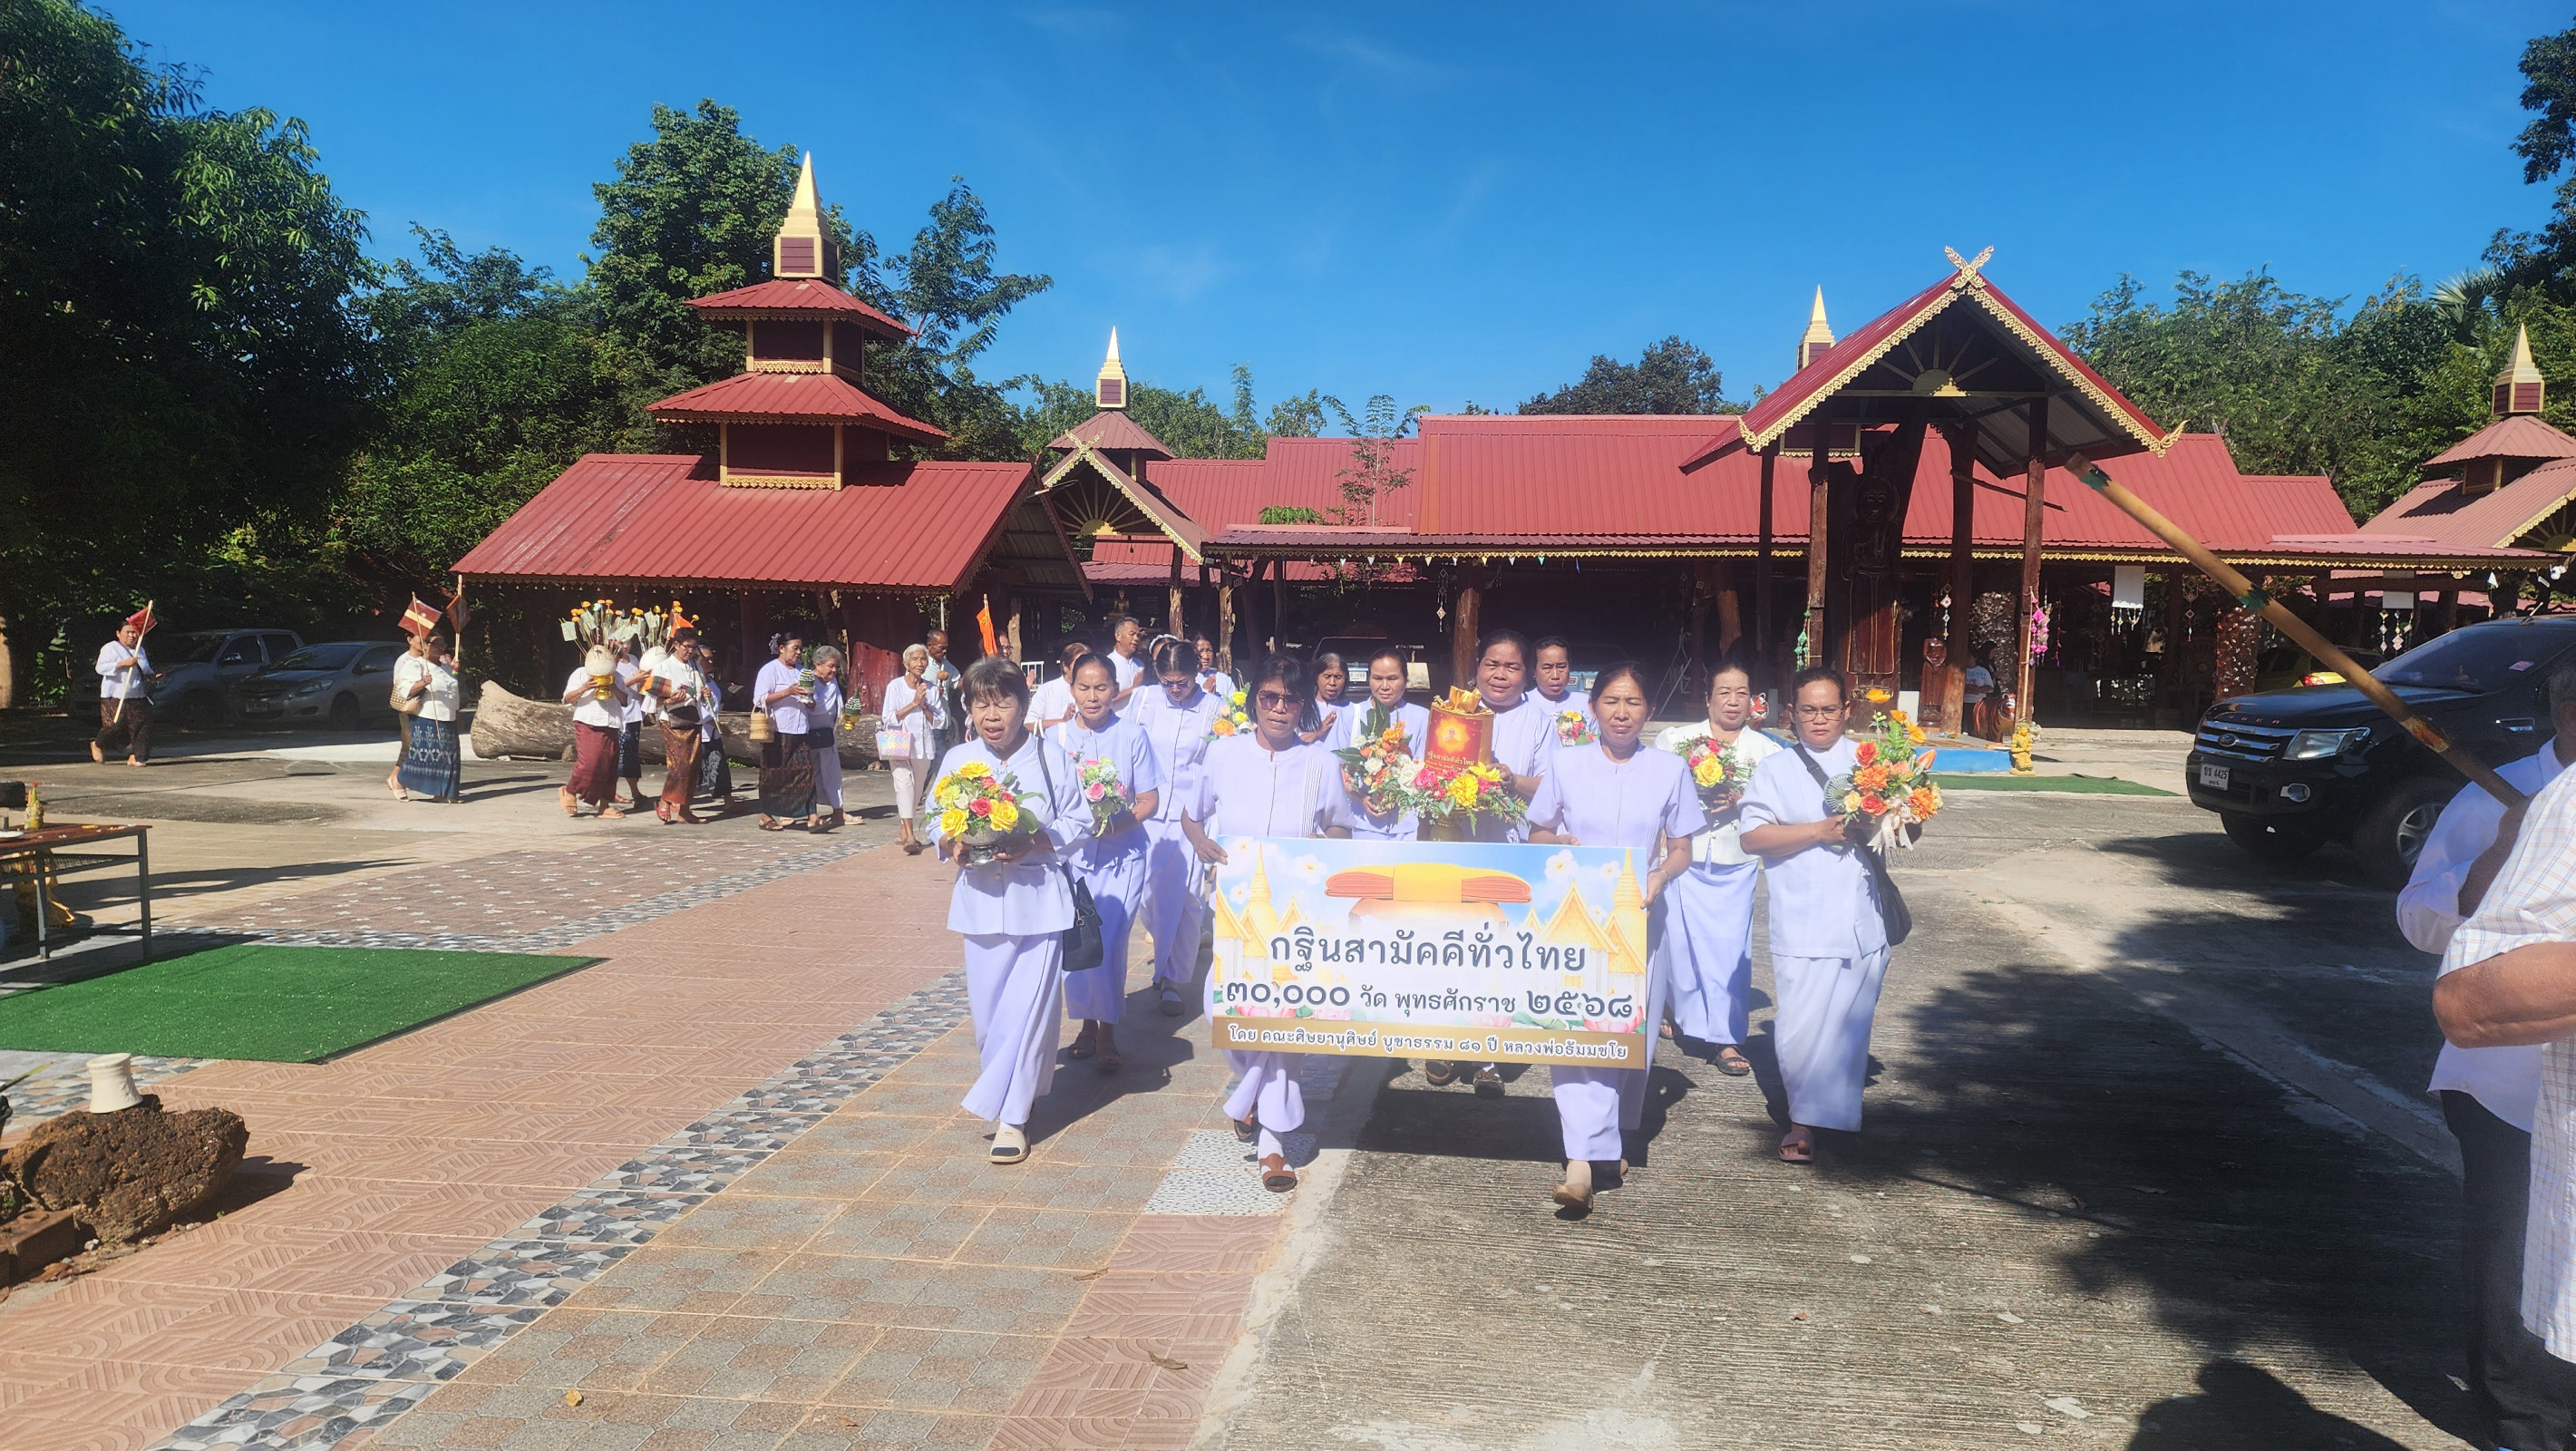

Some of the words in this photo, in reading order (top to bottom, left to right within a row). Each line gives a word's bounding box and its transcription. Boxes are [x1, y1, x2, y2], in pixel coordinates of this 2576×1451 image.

[2213, 768, 2228, 780] 4425
[1270, 921, 1586, 973] กฐินสามัคคีทั่วไทย
[1226, 981, 1351, 1008] ๓๐,๐๐๐
[1360, 984, 1387, 1008] วัด
[1395, 988, 1516, 1018] พุทธศักราช
[1526, 989, 1633, 1018] ๒๕๖๘
[1230, 1025, 1257, 1041] โดย
[1262, 1027, 1378, 1049] คณะศิษยานุศิษย์
[1383, 1036, 1453, 1052] บูชาธรรม
[1459, 1040, 1482, 1052] ๘๑
[1487, 1035, 1499, 1052] ปี
[1503, 1039, 1628, 1058] หลวงพ่อธัมมชโย
